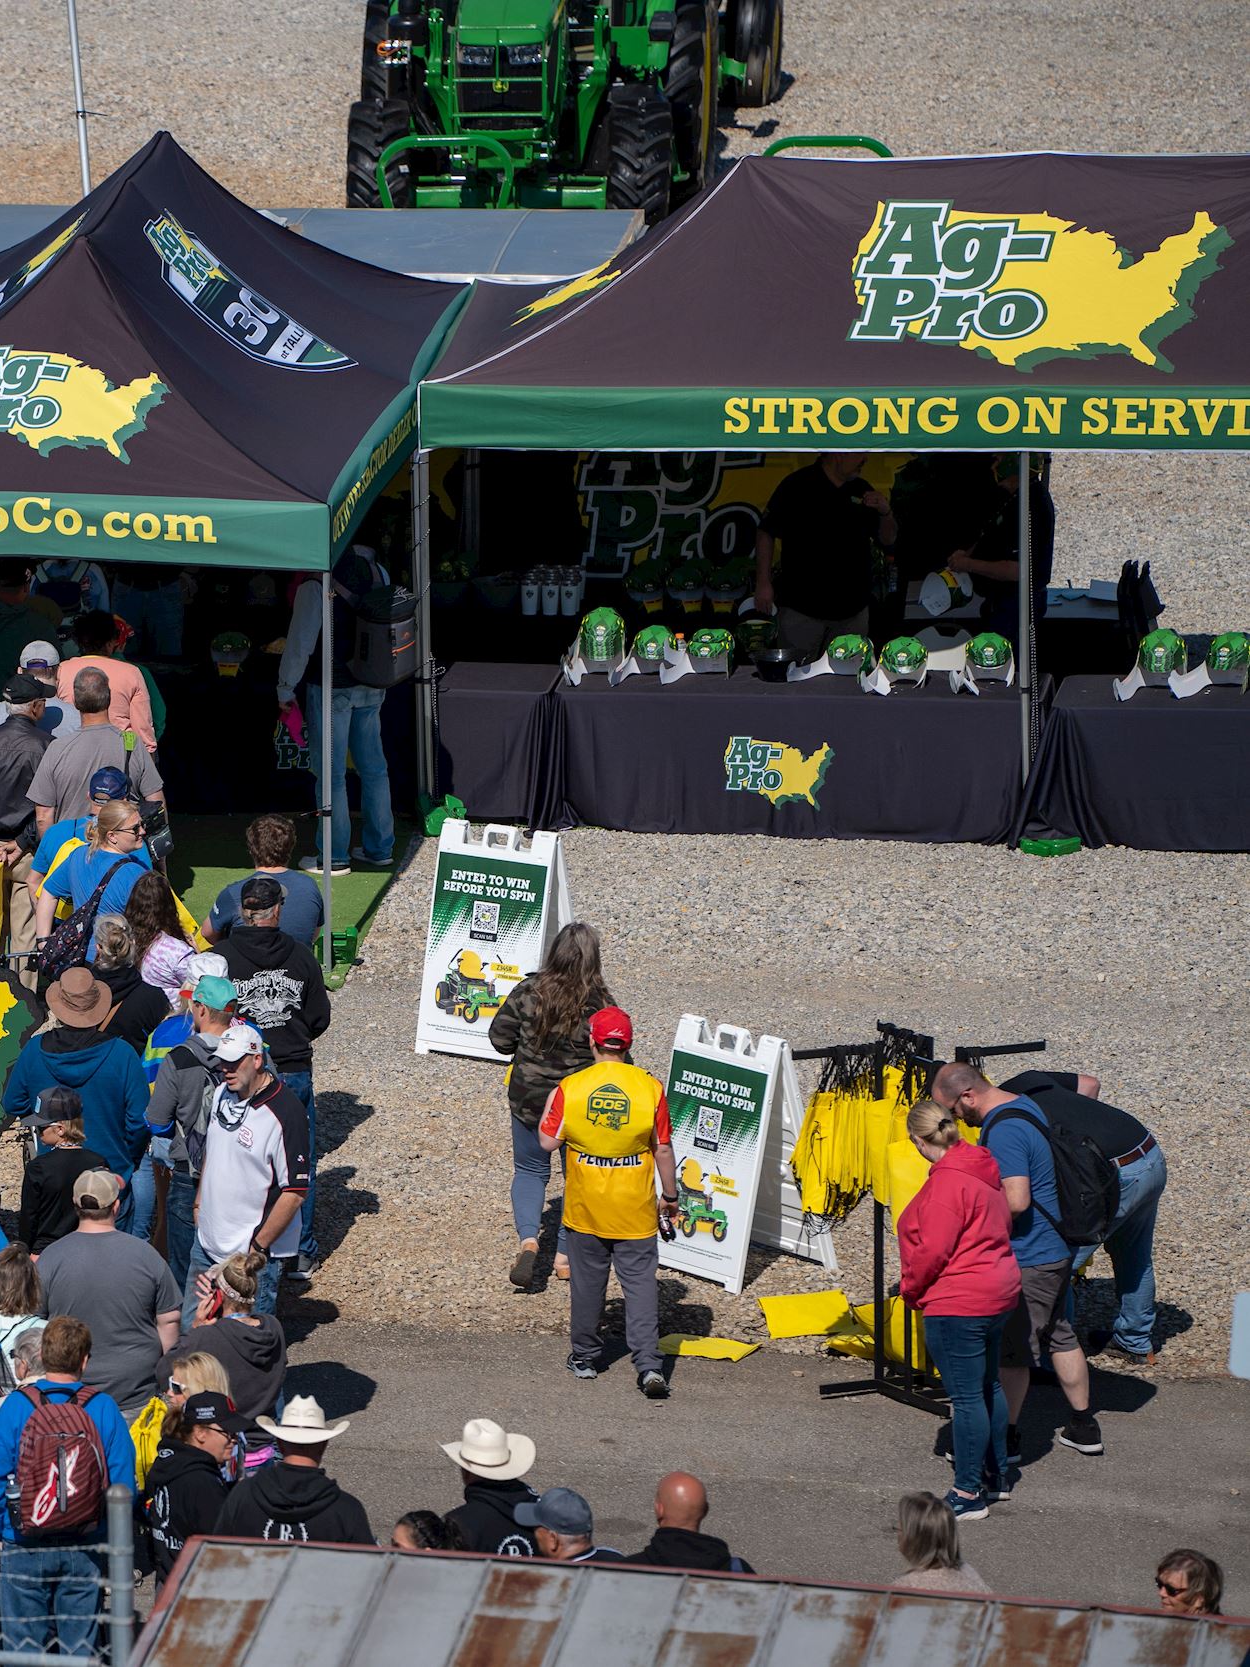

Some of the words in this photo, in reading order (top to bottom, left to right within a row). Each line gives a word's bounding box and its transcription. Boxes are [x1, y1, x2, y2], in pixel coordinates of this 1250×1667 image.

[146, 222, 189, 263] Ag-
[856, 200, 1056, 293] Ag-
[173, 247, 215, 293] Pro
[845, 277, 1048, 341] Pro
[724, 396, 959, 437] STRONG
[977, 396, 1067, 436] ON
[1081, 397, 1250, 436] SERVI
[579, 487, 761, 579] Pro
[277, 743, 310, 768] Pr
[727, 737, 782, 769] Ag-
[726, 763, 782, 790] Pro
[443, 880, 484, 895] BEFORE
[486, 886, 508, 898] YOU
[510, 890, 536, 902] SPIN
[451, 869, 487, 884] ENTER
[489, 874, 504, 886] TO
[506, 877, 531, 890] WIN
[674, 1081, 710, 1100] BEFORE
[711, 1090, 732, 1105] YOU
[732, 1096, 756, 1112] SPIN
[682, 1070, 713, 1088] ENTER
[715, 1079, 728, 1091] TO
[730, 1082, 752, 1098] WIN
[592, 1099, 625, 1111] 300
